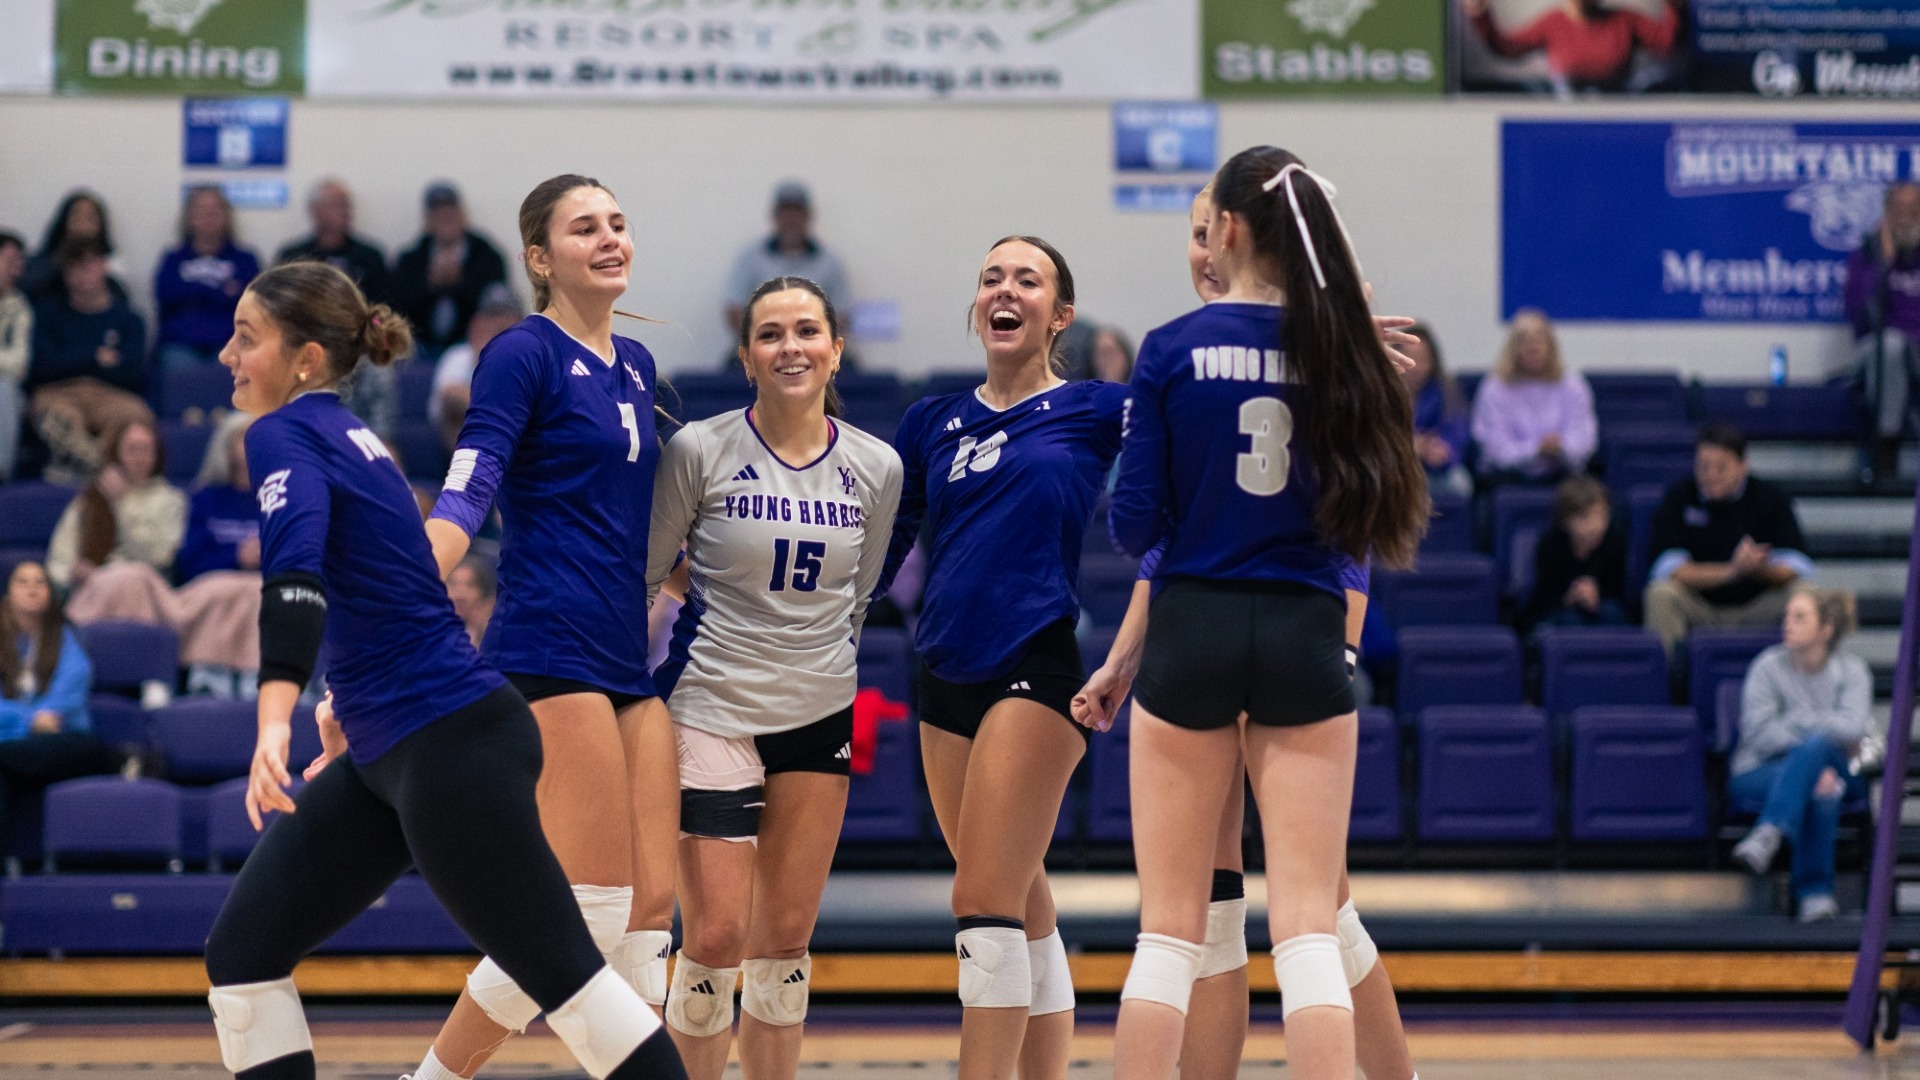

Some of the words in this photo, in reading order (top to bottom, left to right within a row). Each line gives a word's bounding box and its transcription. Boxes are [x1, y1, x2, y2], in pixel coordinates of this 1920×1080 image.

[505, 21, 775, 48] RESORT
[882, 24, 1002, 50] SPA
[87, 37, 280, 88] Dining
[1217, 42, 1435, 82] Stables
[1677, 142, 1898, 187] MOUNTAIN
[1191, 345, 1261, 381] YOUNG
[616, 401, 641, 463] 7
[1235, 396, 1294, 496] 3
[725, 493, 792, 523] YOUNG
[797, 499, 862, 530] HARRIS
[768, 537, 827, 593] 15
